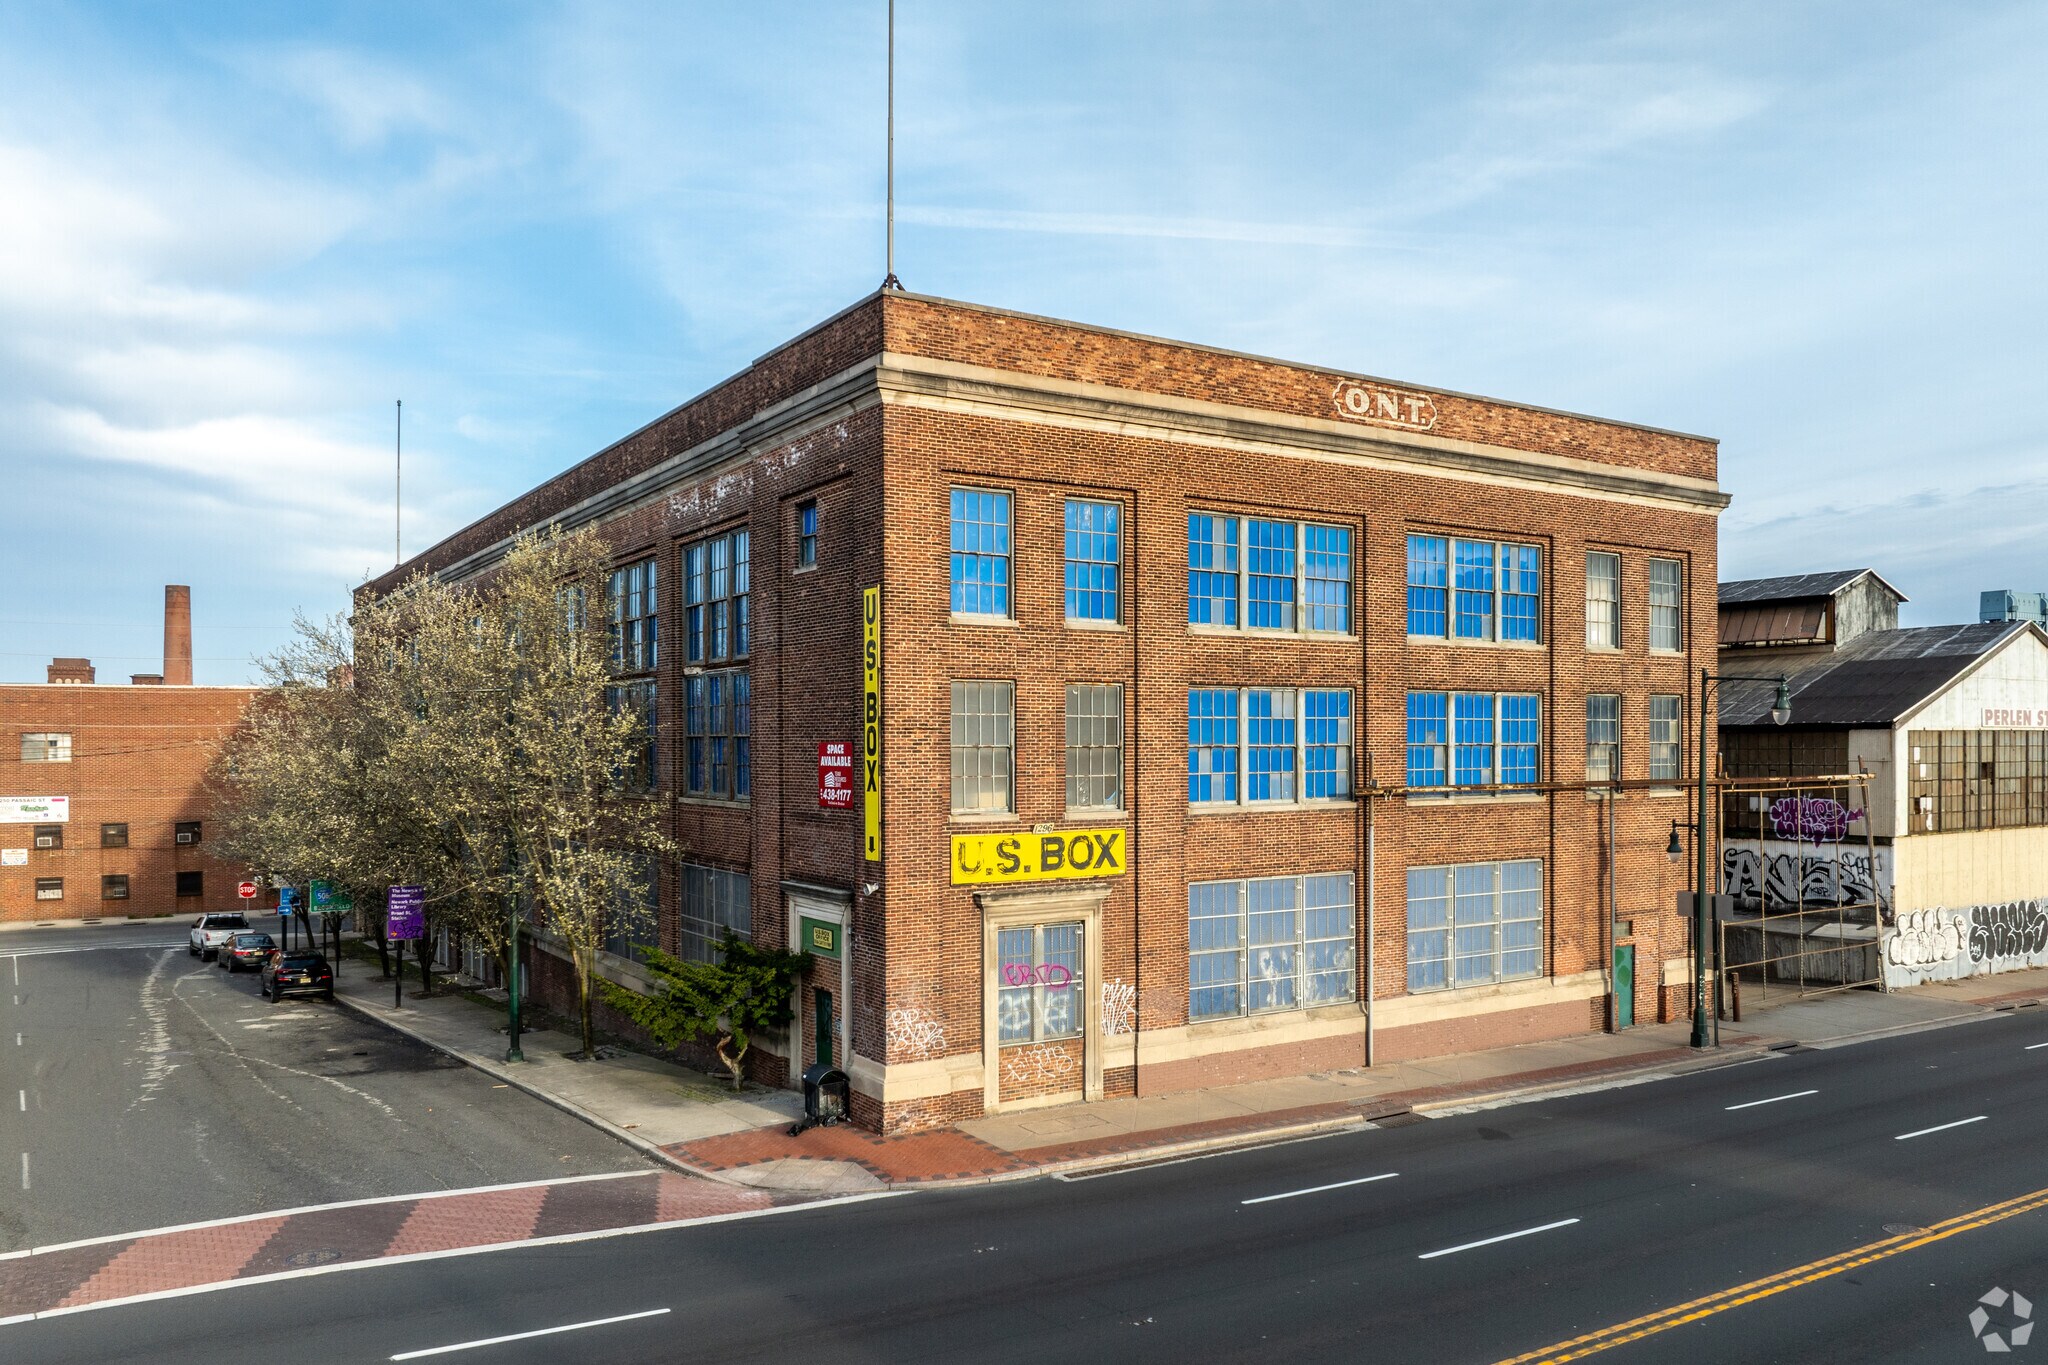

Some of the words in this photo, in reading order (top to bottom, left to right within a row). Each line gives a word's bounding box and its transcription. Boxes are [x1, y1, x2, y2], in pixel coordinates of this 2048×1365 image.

[1345, 387, 1426, 424] O.N.T.
[1985, 709, 2032, 726] PERLEN
[827, 744, 845, 754] SPACE
[820, 756, 851, 766] AVAILABLE
[823, 788, 852, 801] 438-1177
[957, 838, 1031, 876] U.S.
[1041, 833, 1120, 872] BOX
